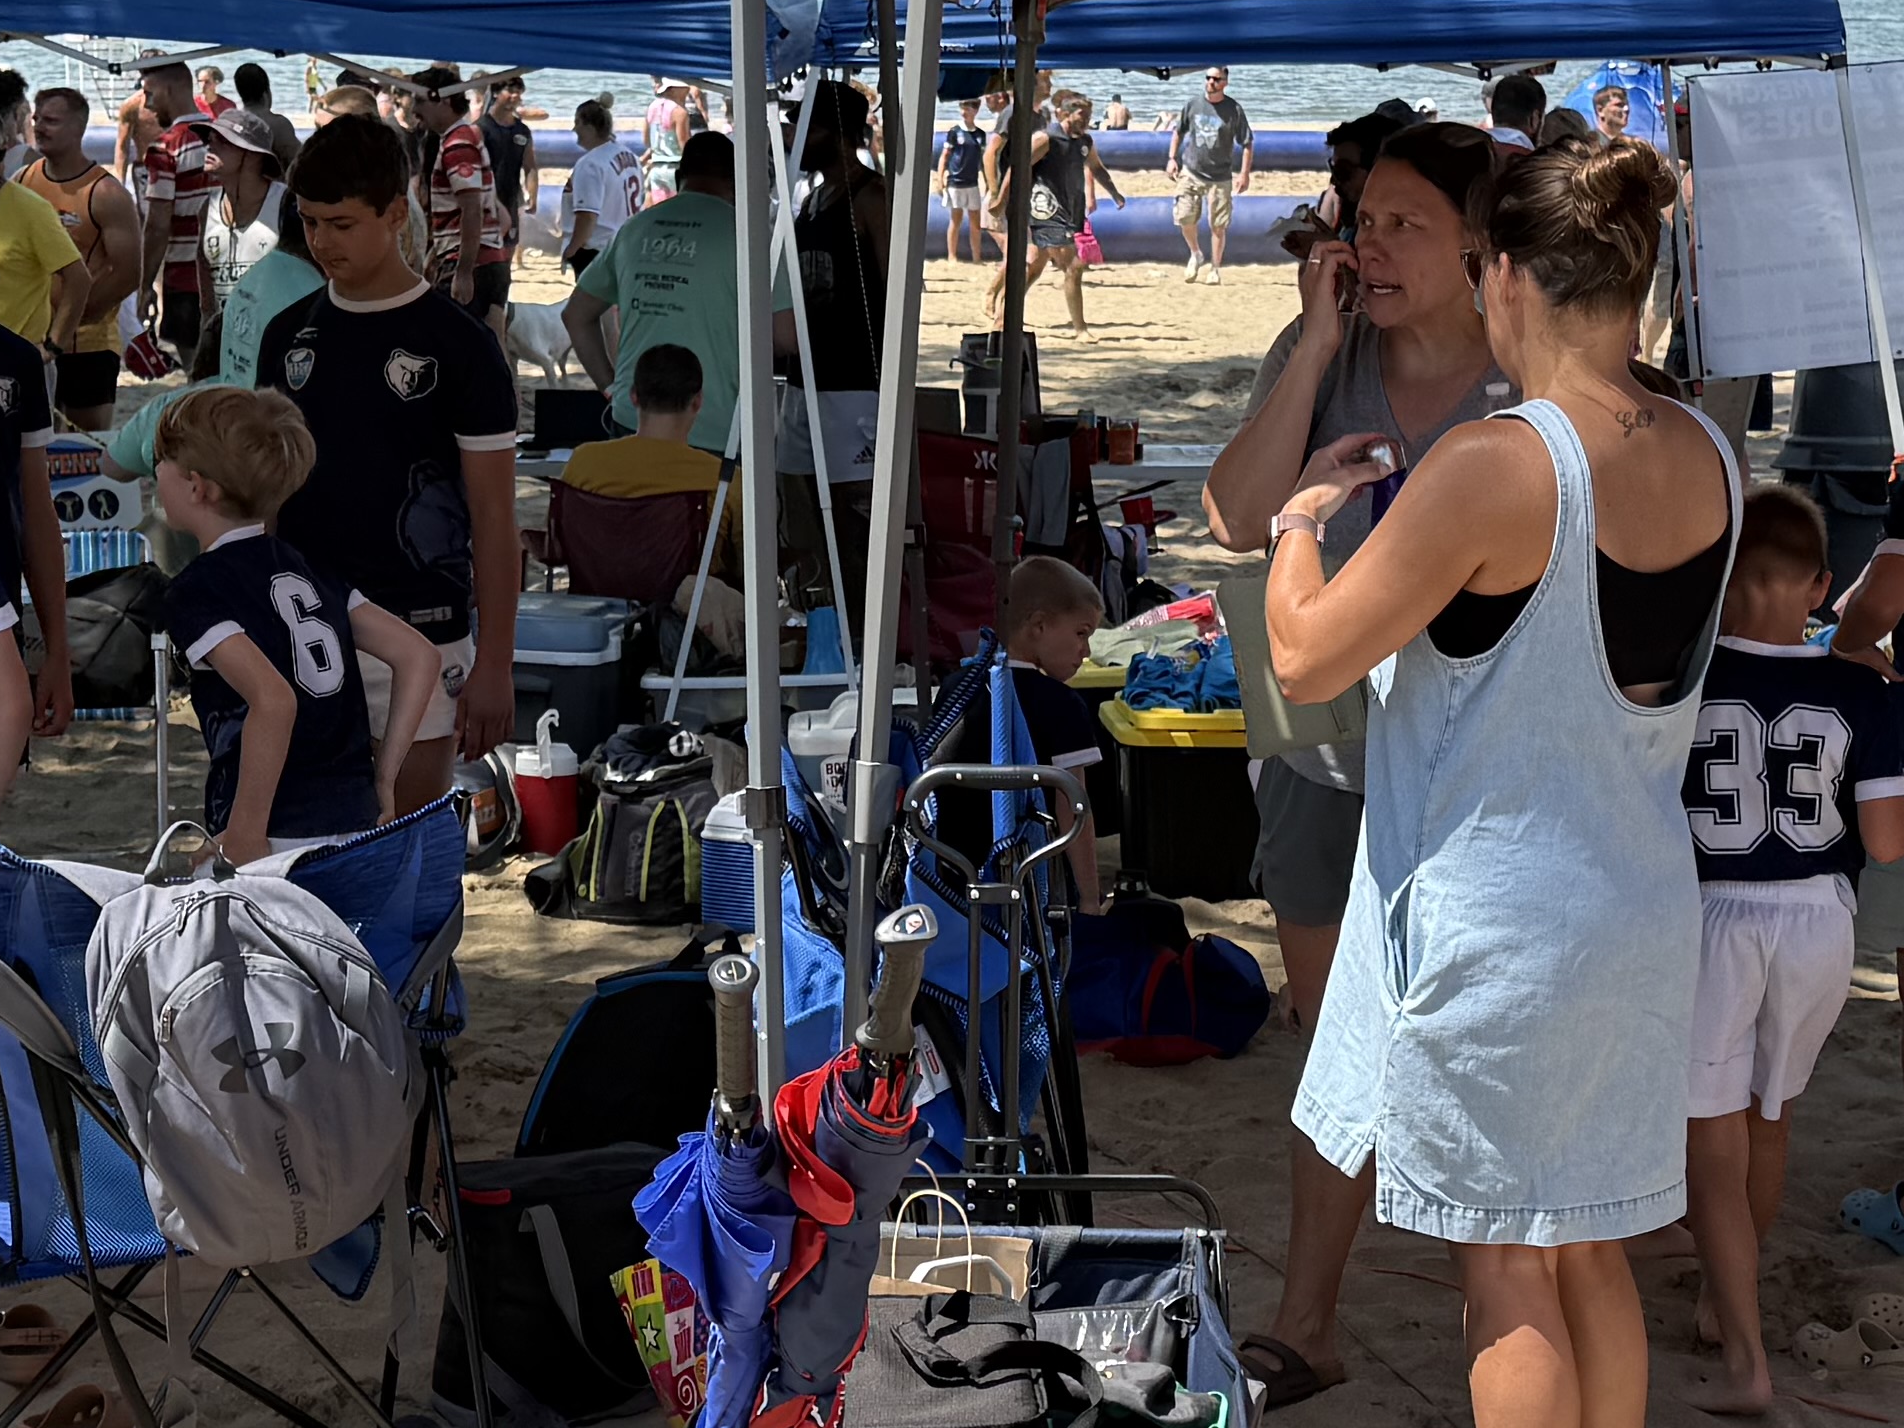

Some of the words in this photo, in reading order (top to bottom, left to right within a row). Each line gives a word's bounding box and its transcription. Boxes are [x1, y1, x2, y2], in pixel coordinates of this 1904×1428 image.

[624, 175, 642, 217] 12
[641, 236, 697, 259] 1964
[270, 573, 345, 698] 6
[1686, 699, 1854, 854] 33
[274, 1125, 302, 1197] UNDER
